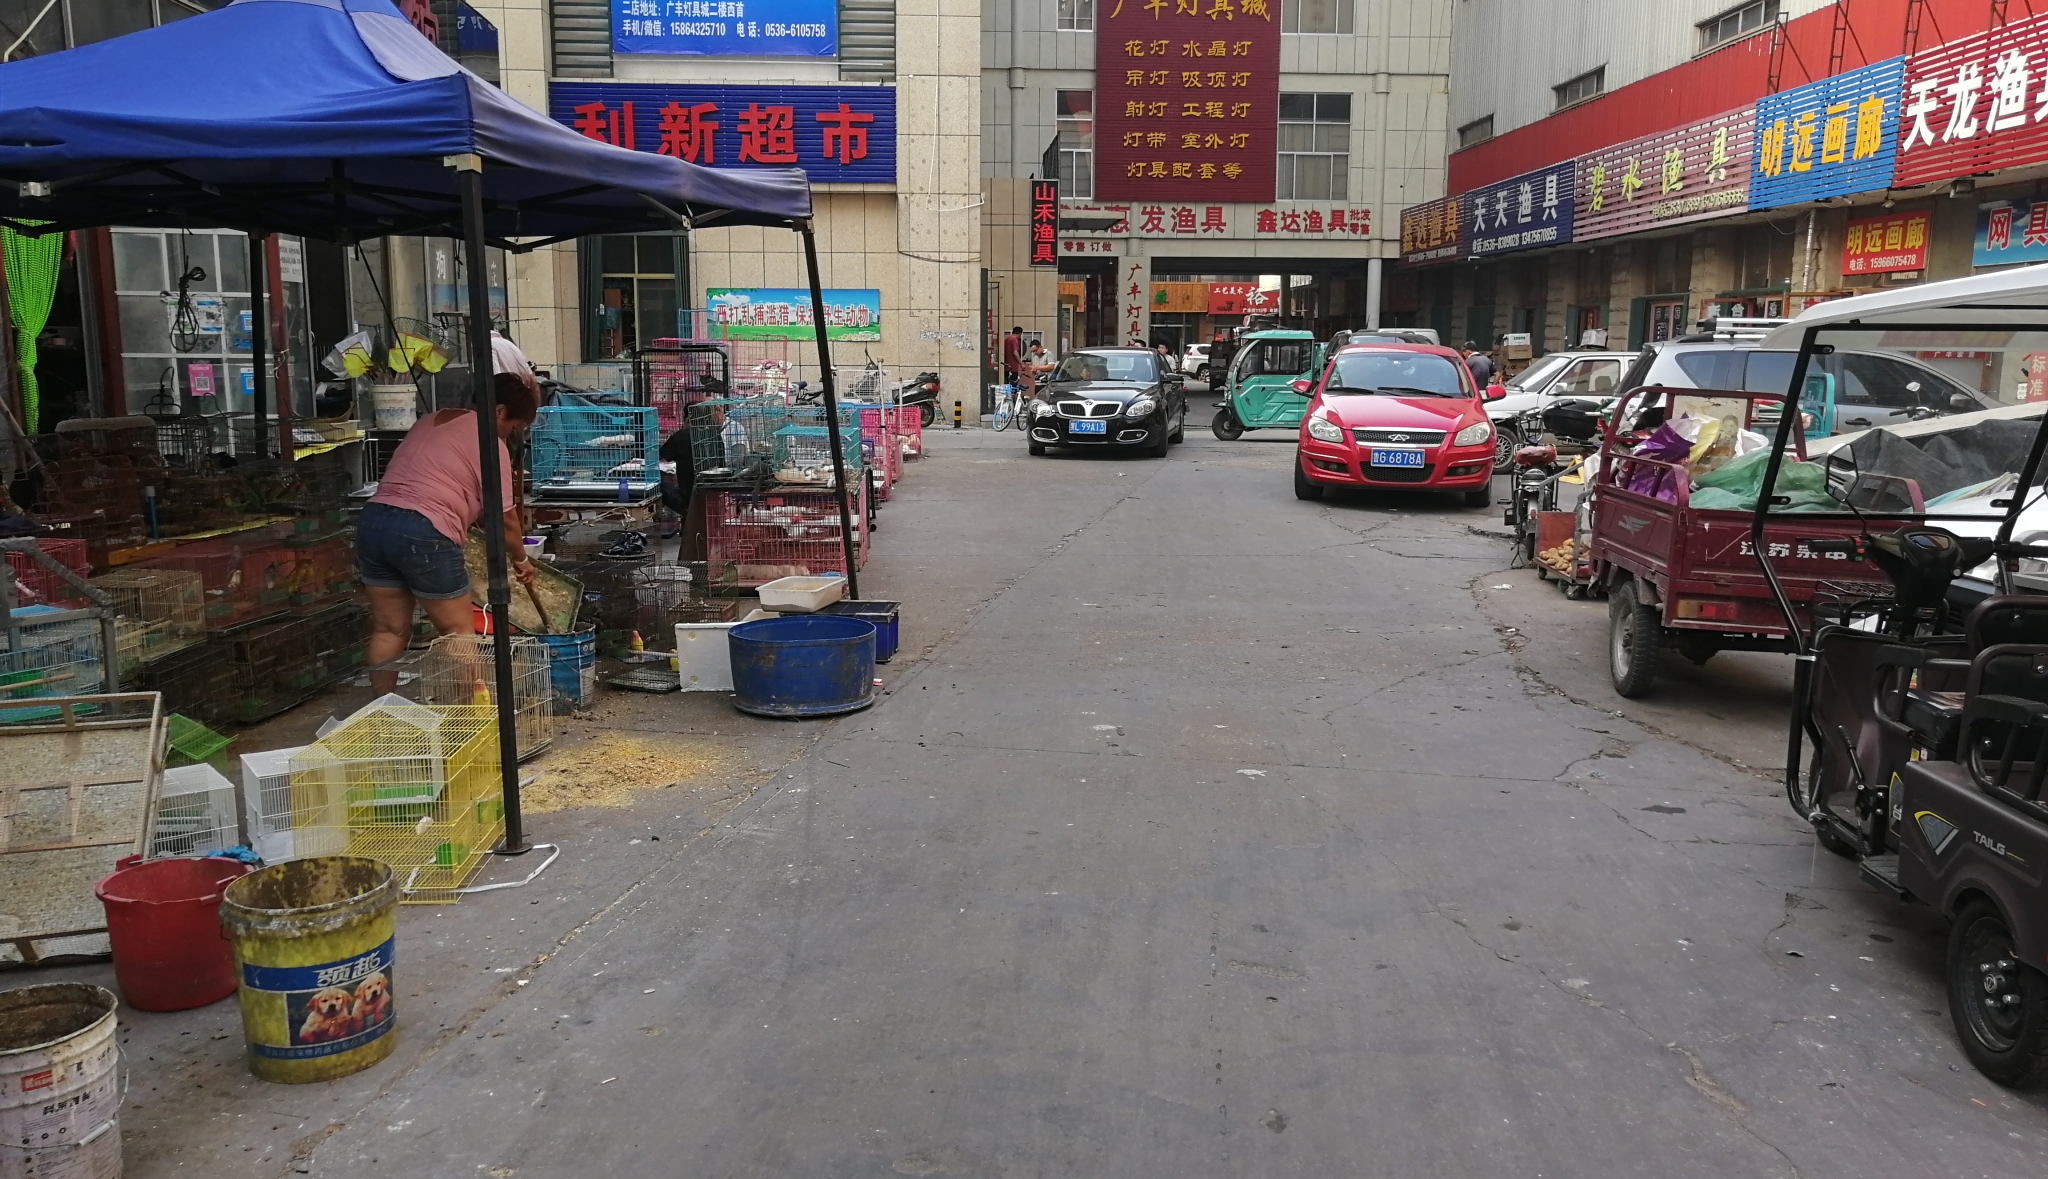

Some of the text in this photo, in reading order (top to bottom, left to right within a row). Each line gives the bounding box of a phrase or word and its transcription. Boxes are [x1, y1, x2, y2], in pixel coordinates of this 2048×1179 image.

[1125, 40, 1252, 58] 花灯 水晶灯
[1125, 69, 1252, 88] 吊灯 吸顶灯
[1125, 101, 1251, 119] 射灯 工程灯
[573, 101, 874, 164] 利新超市
[1123, 131, 1250, 149] 灯带 室外灯
[1759, 94, 1885, 179] 明远画廊
[1127, 161, 1243, 180] 灯具配套等
[1473, 174, 1560, 234] 天天渔具
[1033, 182, 1056, 263] 山禾渔具
[1257, 208, 1347, 233] 鑫达渔具
[1986, 202, 2048, 251] 网具
[1846, 216, 1927, 256] 明远画廊
[716, 303, 790, 326] 严打乱捕滥猎
[1973, 830, 2006, 856] TAILG
